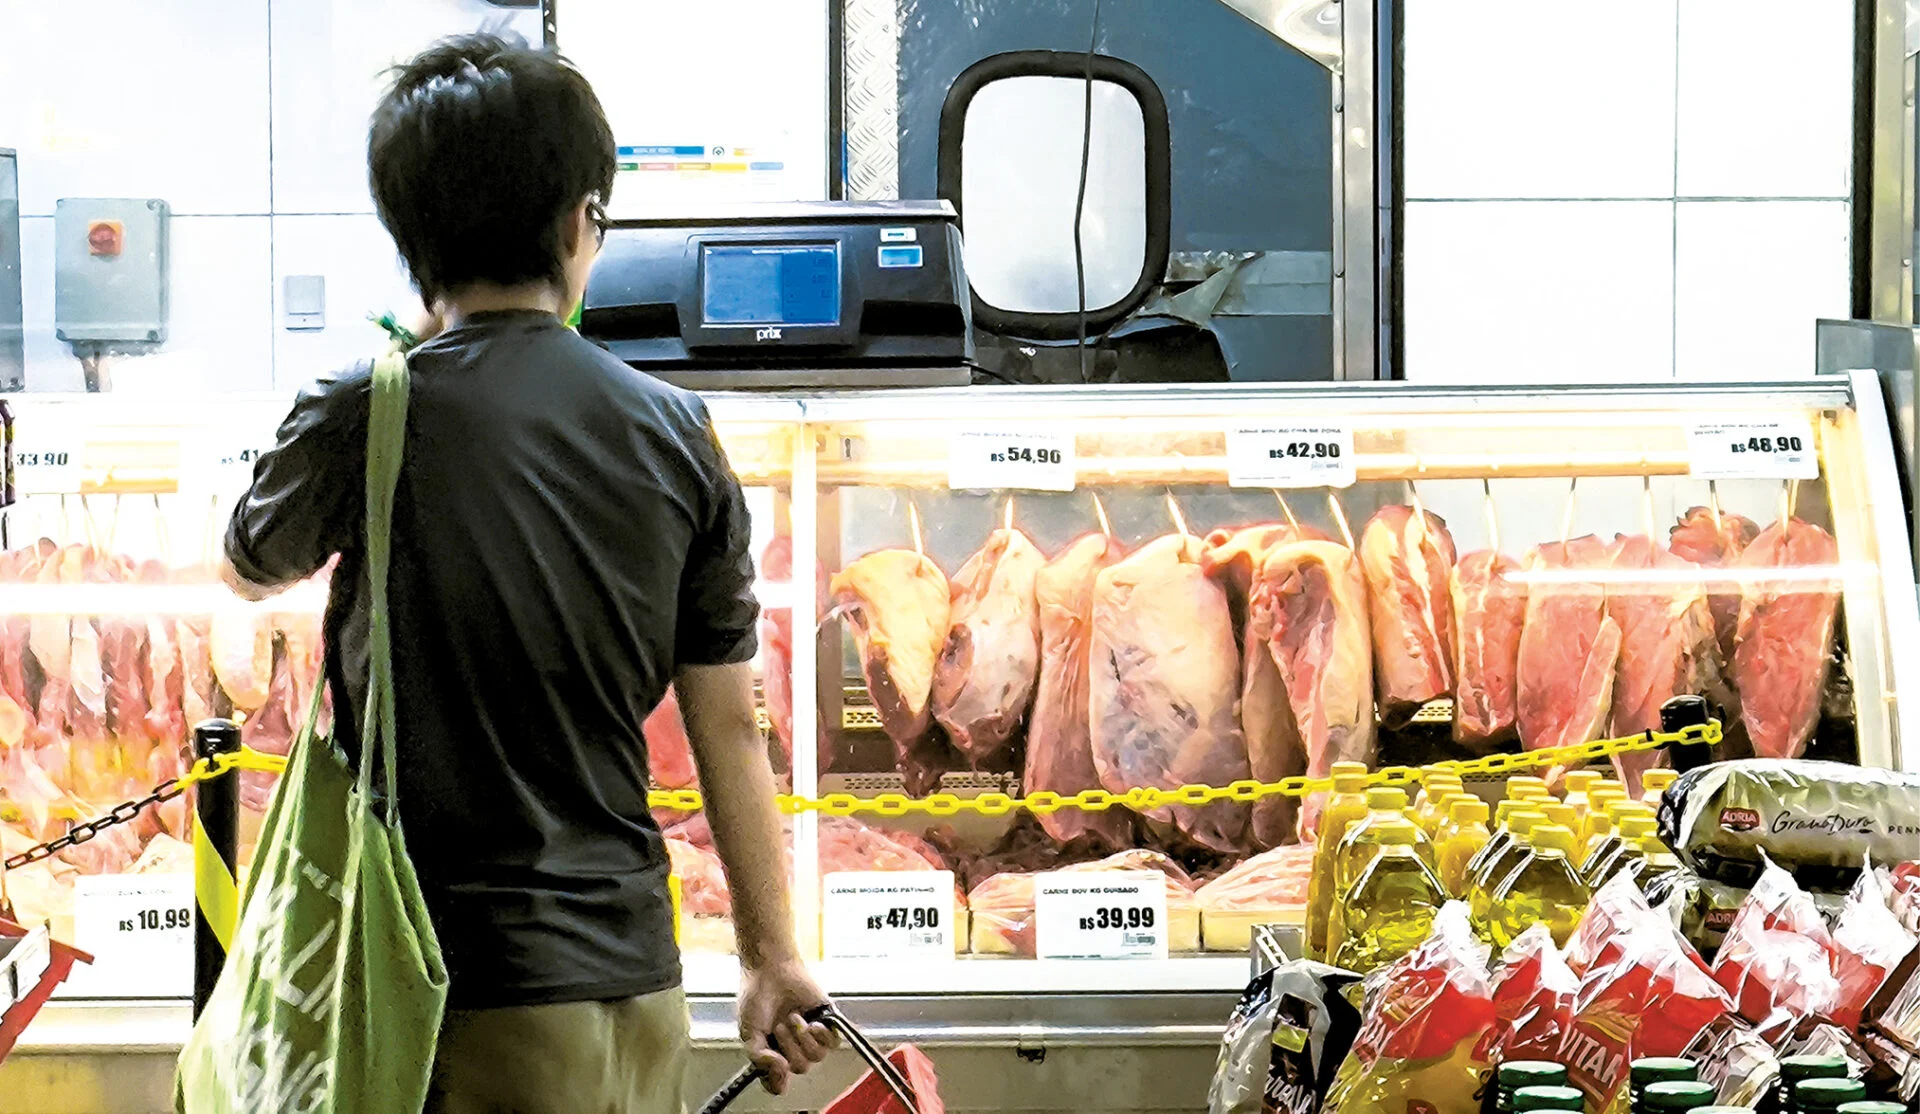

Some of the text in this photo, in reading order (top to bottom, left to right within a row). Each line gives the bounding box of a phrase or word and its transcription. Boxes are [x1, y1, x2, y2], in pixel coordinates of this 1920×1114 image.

[756, 326, 782, 341] prix
[1286, 441, 1341, 459] 42,90
[1748, 436, 1803, 454] 48,90
[16, 452, 69, 466] 3390
[1007, 446, 1062, 464] 54,90
[1722, 808, 1757, 824] ADRIA
[137, 908, 191, 931] 10,99
[886, 907, 939, 931] 47,90
[1096, 906, 1155, 931] 39,99
